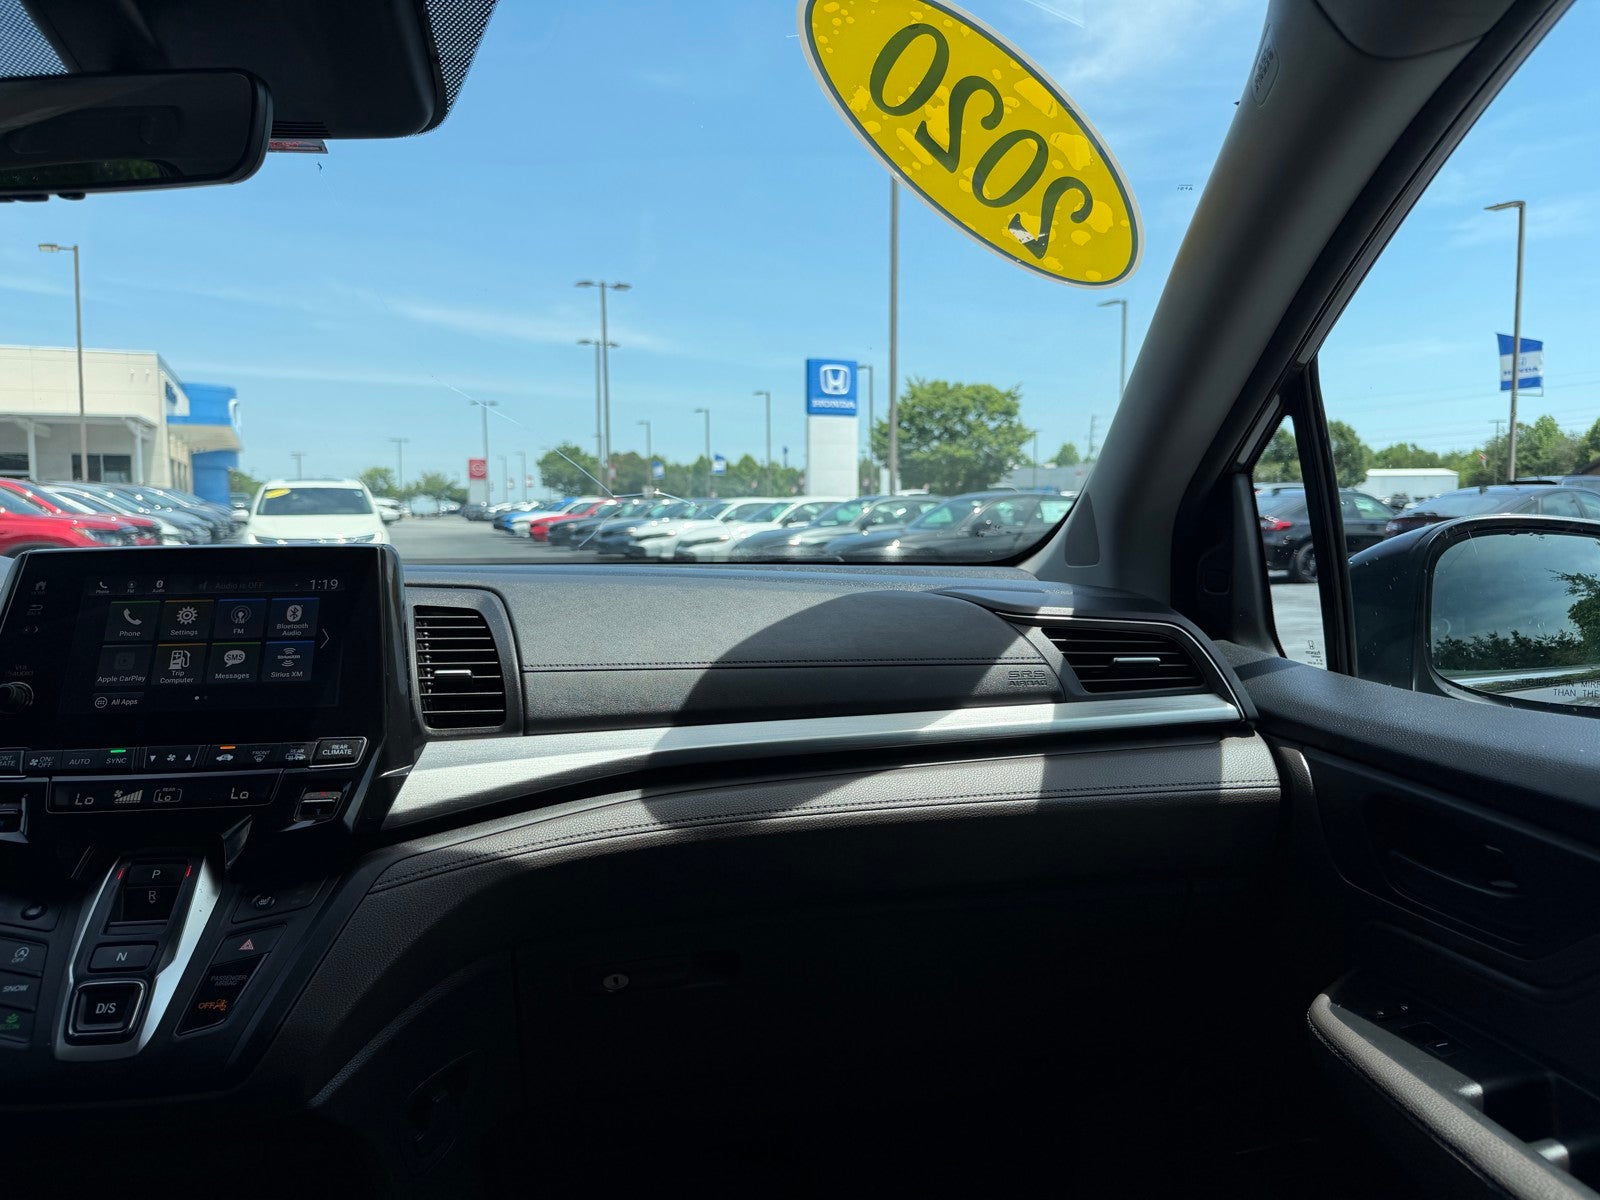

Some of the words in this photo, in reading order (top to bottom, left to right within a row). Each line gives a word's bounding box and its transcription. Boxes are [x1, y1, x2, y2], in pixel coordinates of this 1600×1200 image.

[310, 579, 339, 590] 1:19
[1008, 670, 1046, 678] SRS
[119, 675, 146, 683] CarPlay
[1553, 688, 1577, 697] THAN
[121, 698, 138, 706] Apps
[230, 787, 249, 800] Lo
[75, 792, 94, 806] Lo
[151, 869, 161, 879] P
[148, 890, 157, 900] R
[116, 952, 128, 961] N
[3, 984, 29, 992] SNOW
[95, 1002, 117, 1014] D/S
